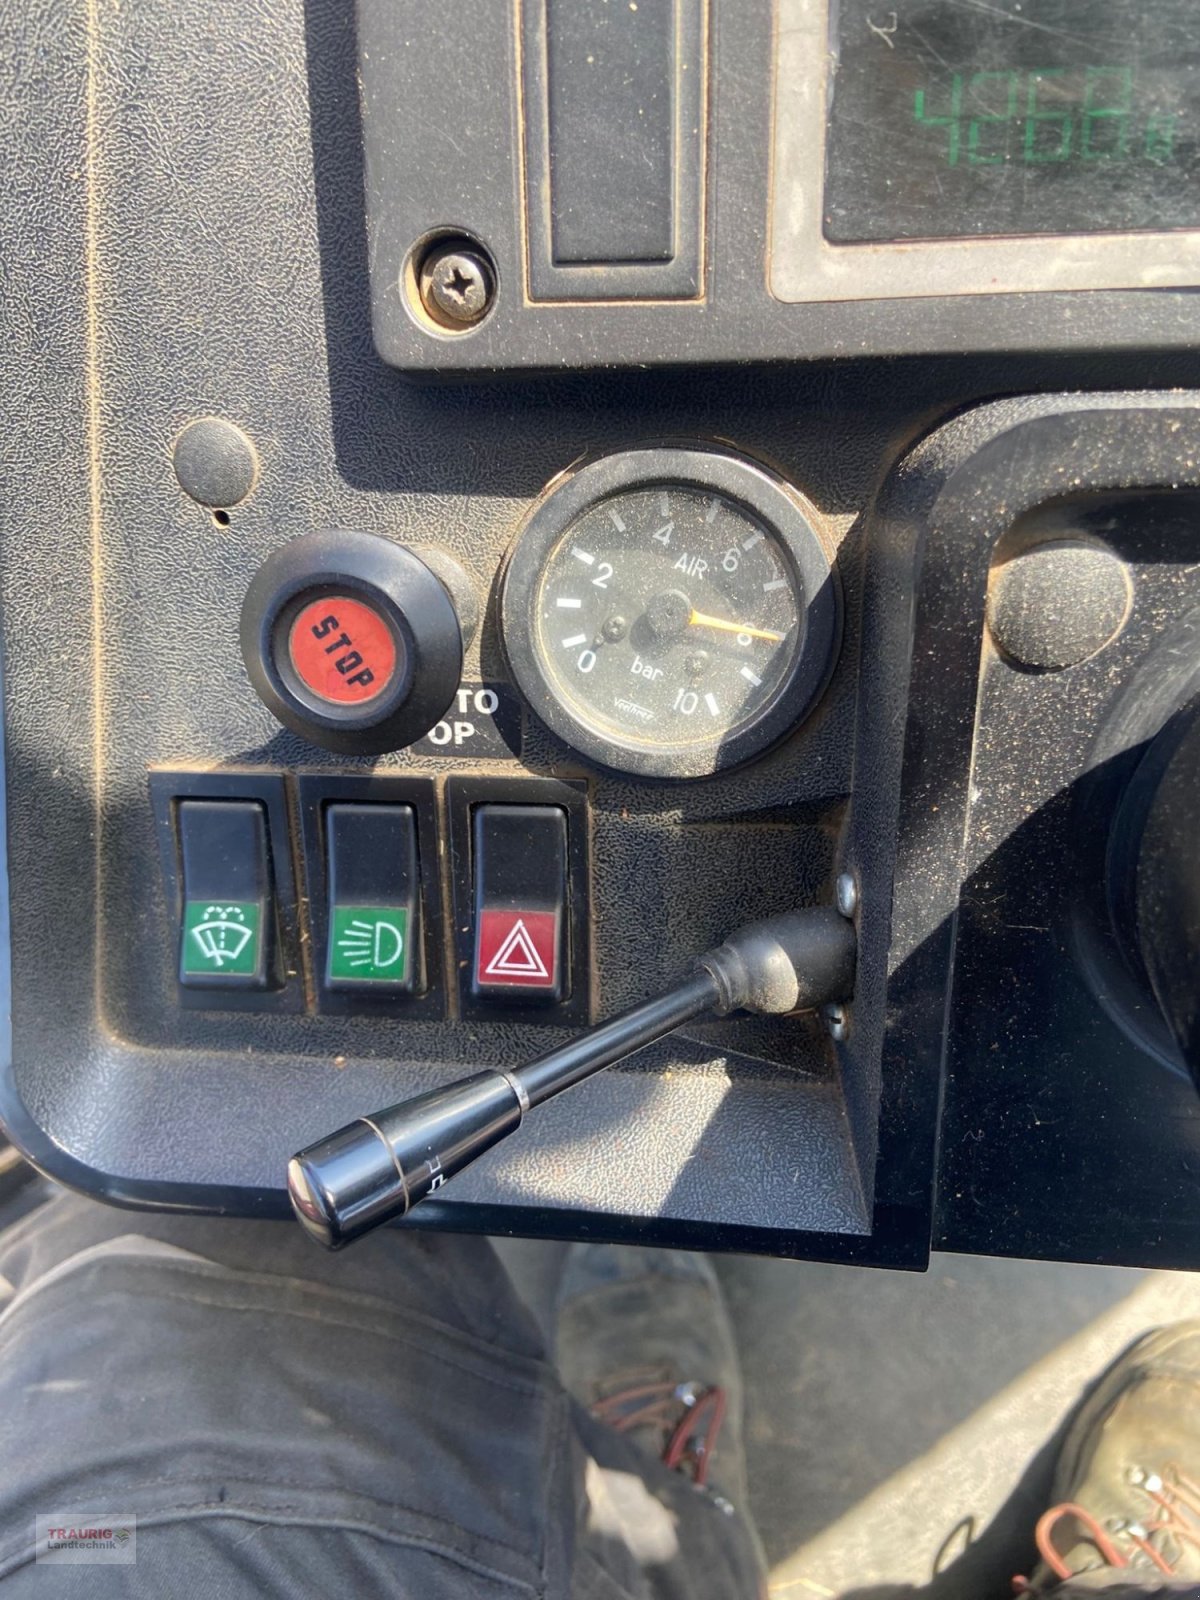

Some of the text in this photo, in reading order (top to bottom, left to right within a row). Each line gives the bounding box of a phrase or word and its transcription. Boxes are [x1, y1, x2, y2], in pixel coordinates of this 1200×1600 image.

[652, 521, 674, 546] 4
[674, 552, 708, 580] AIR
[722, 549, 742, 572] 6
[592, 564, 613, 588] 2
[311, 615, 375, 687] STOP
[577, 651, 597, 673] 0
[630, 656, 664, 681] bar
[672, 687, 699, 715] 10
